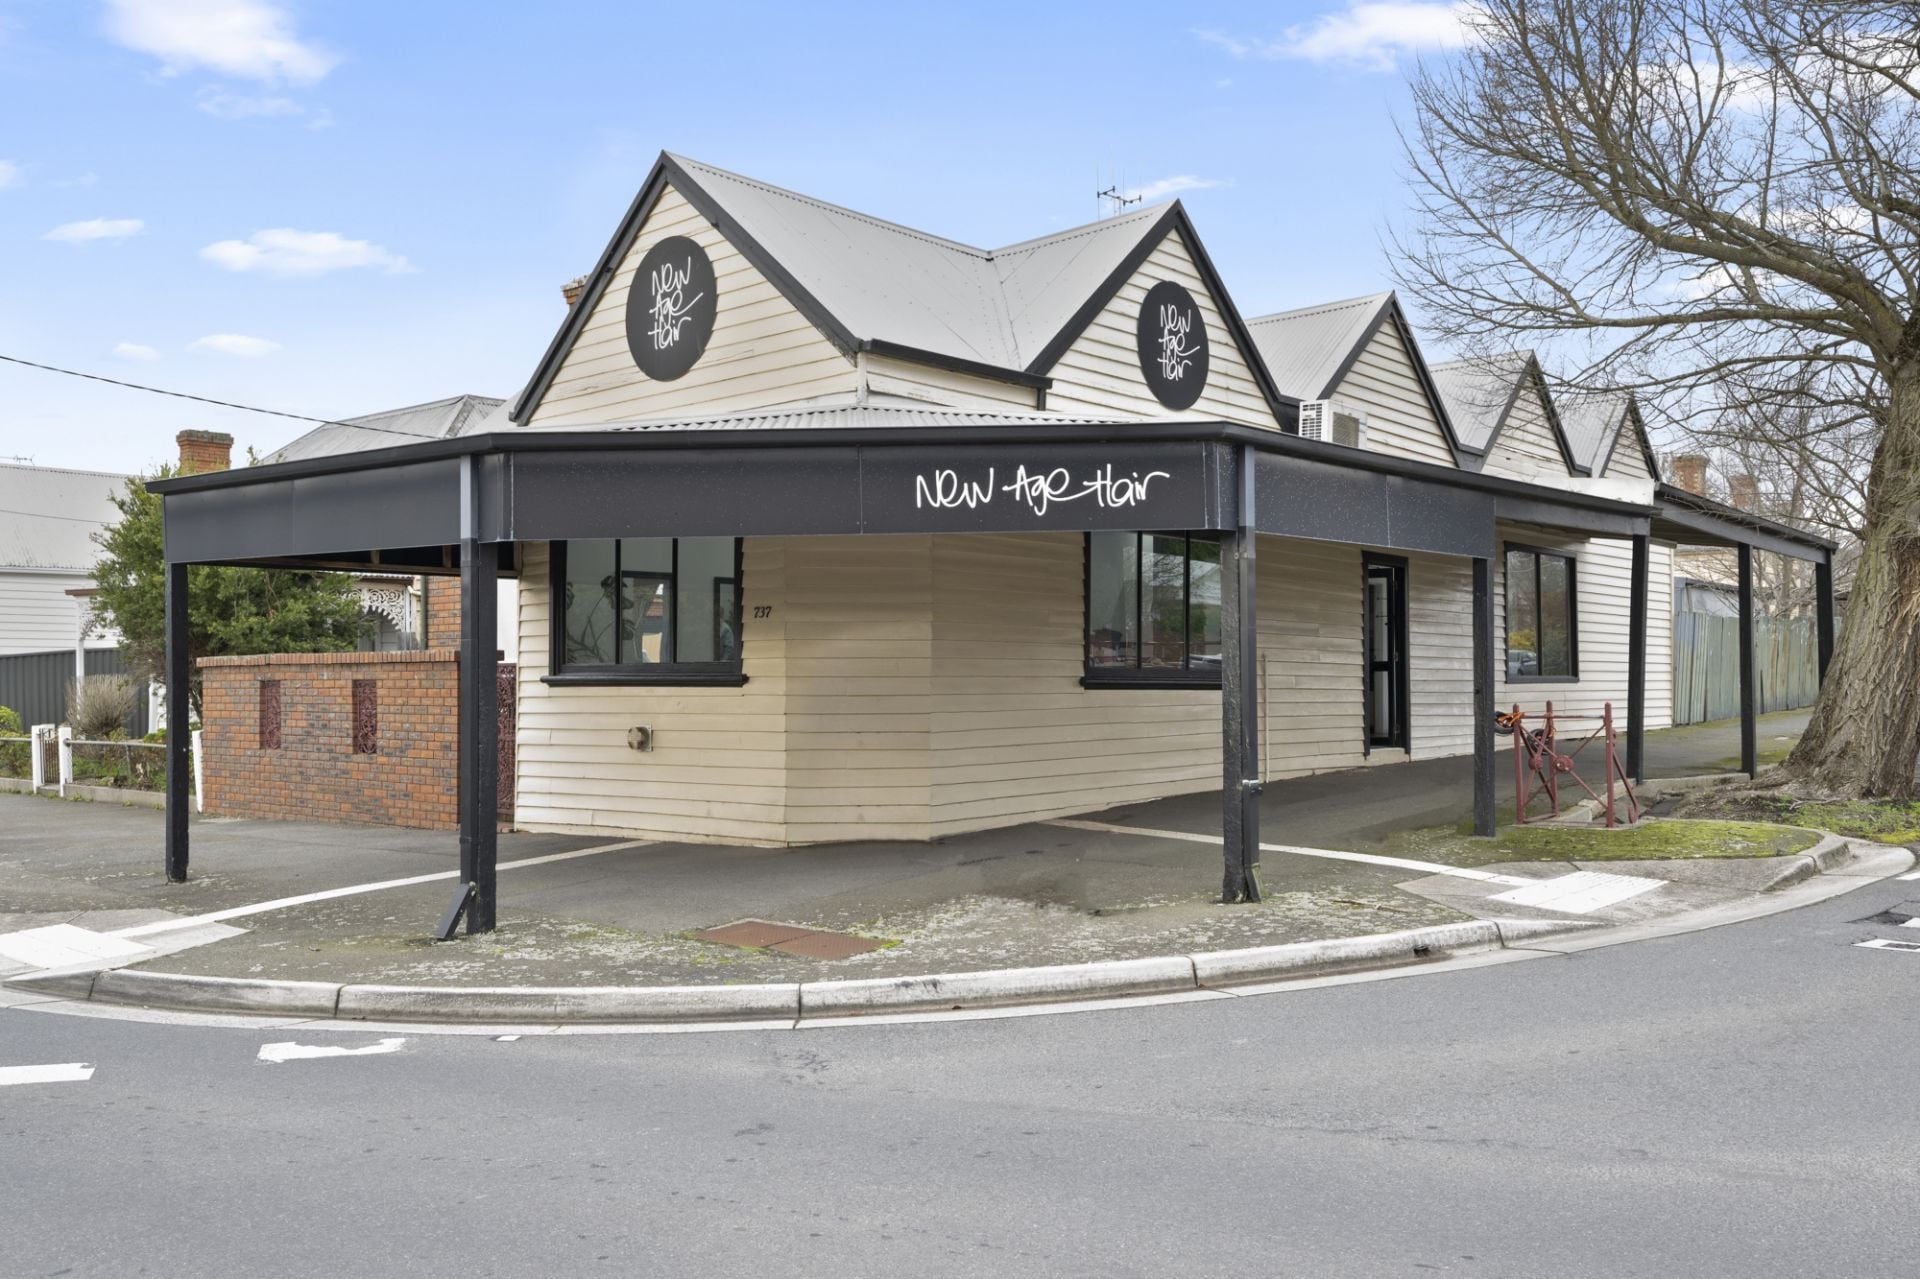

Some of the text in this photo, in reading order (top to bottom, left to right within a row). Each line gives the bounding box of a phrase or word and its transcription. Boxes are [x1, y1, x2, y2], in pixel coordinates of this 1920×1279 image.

[652, 256, 691, 296] New
[649, 290, 703, 328] Age
[1160, 303, 1191, 334] New
[647, 315, 692, 350] Hair
[1158, 326, 1200, 361] Age
[1157, 348, 1192, 381] Hair
[916, 463, 1170, 516] New Age Hair
[753, 606, 772, 618] 737
